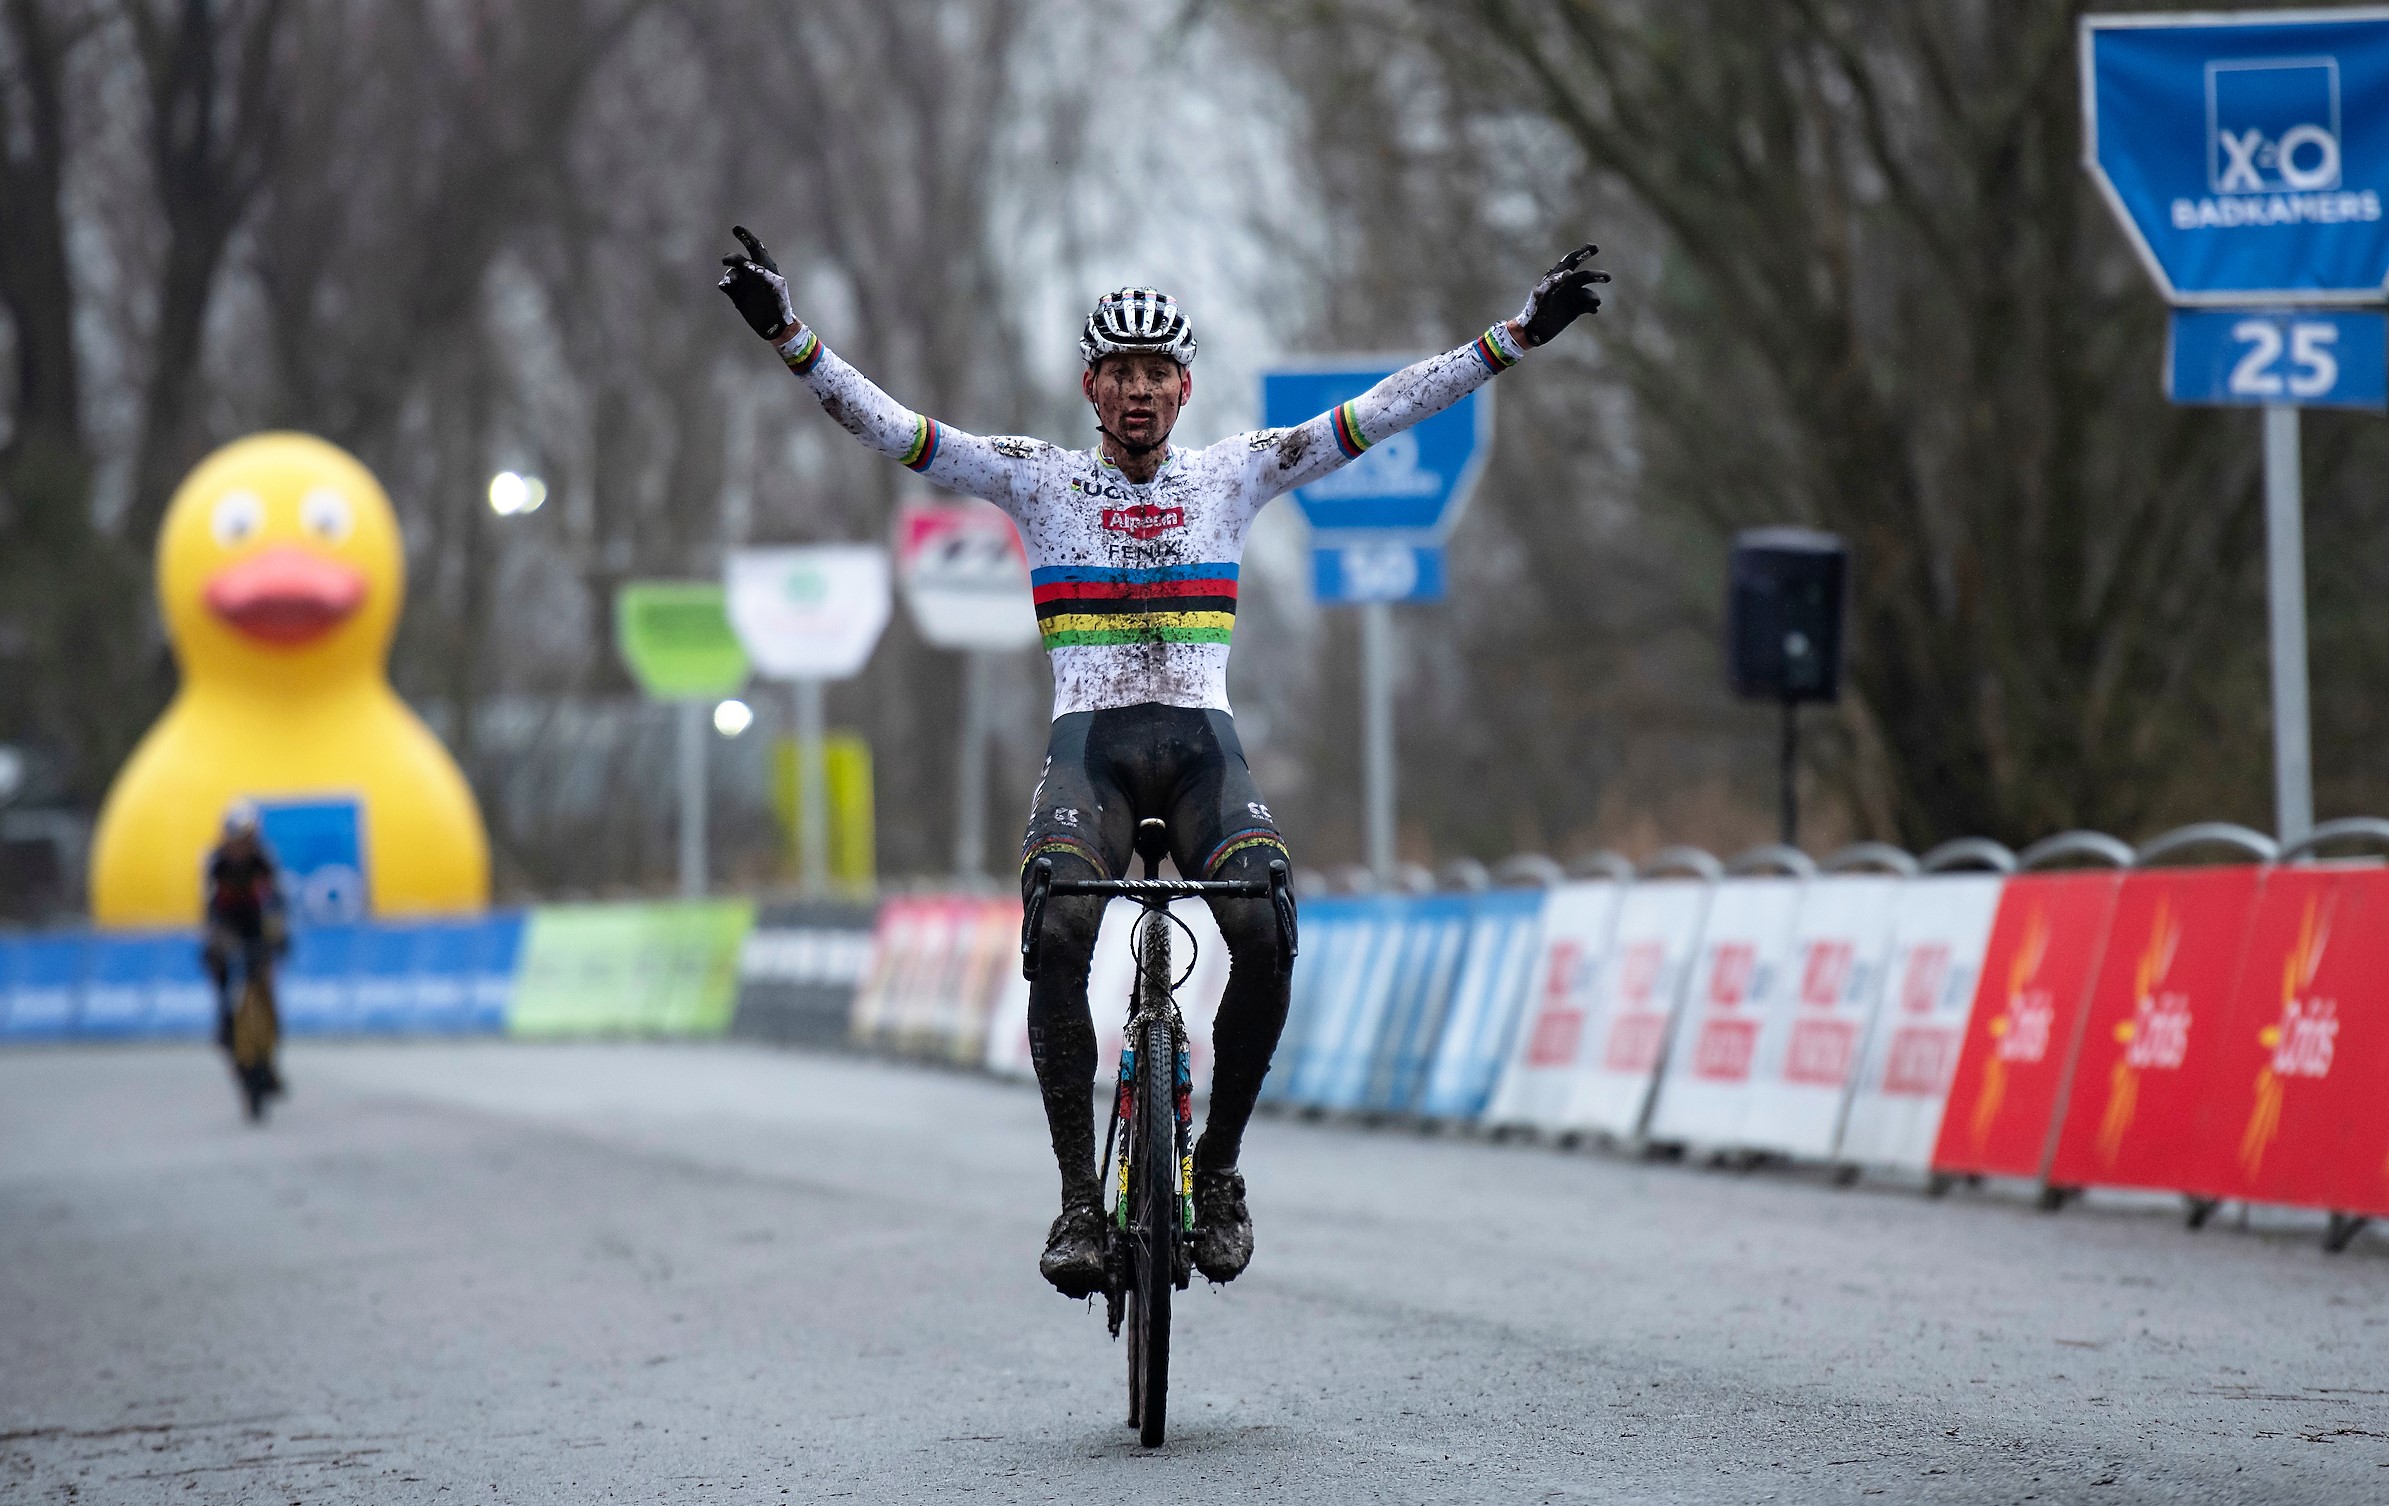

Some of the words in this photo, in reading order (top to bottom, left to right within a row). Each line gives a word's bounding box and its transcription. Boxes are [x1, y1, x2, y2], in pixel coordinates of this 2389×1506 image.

[2171, 191, 2381, 228] BADKAMERS
[2230, 321, 2339, 397] 25
[1109, 539, 1181, 559] FENIX
